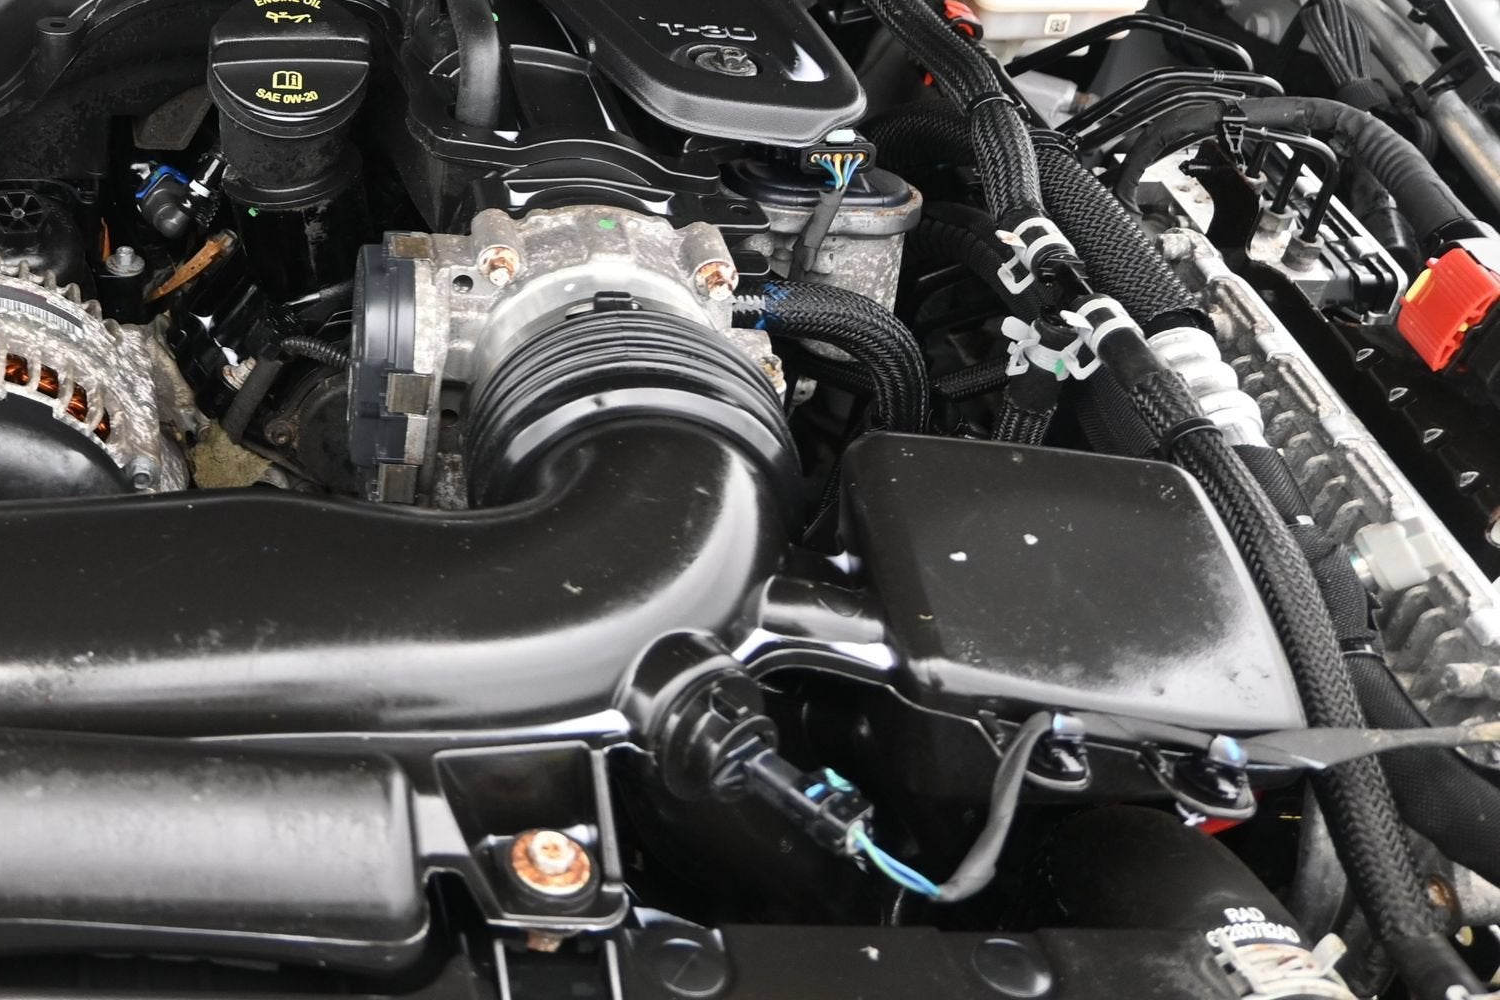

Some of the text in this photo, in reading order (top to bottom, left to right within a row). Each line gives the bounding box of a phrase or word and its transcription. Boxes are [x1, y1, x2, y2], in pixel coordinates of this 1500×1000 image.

[255, 88, 319, 104] SAE 0W-20
[1223, 906, 1266, 923] RAD
